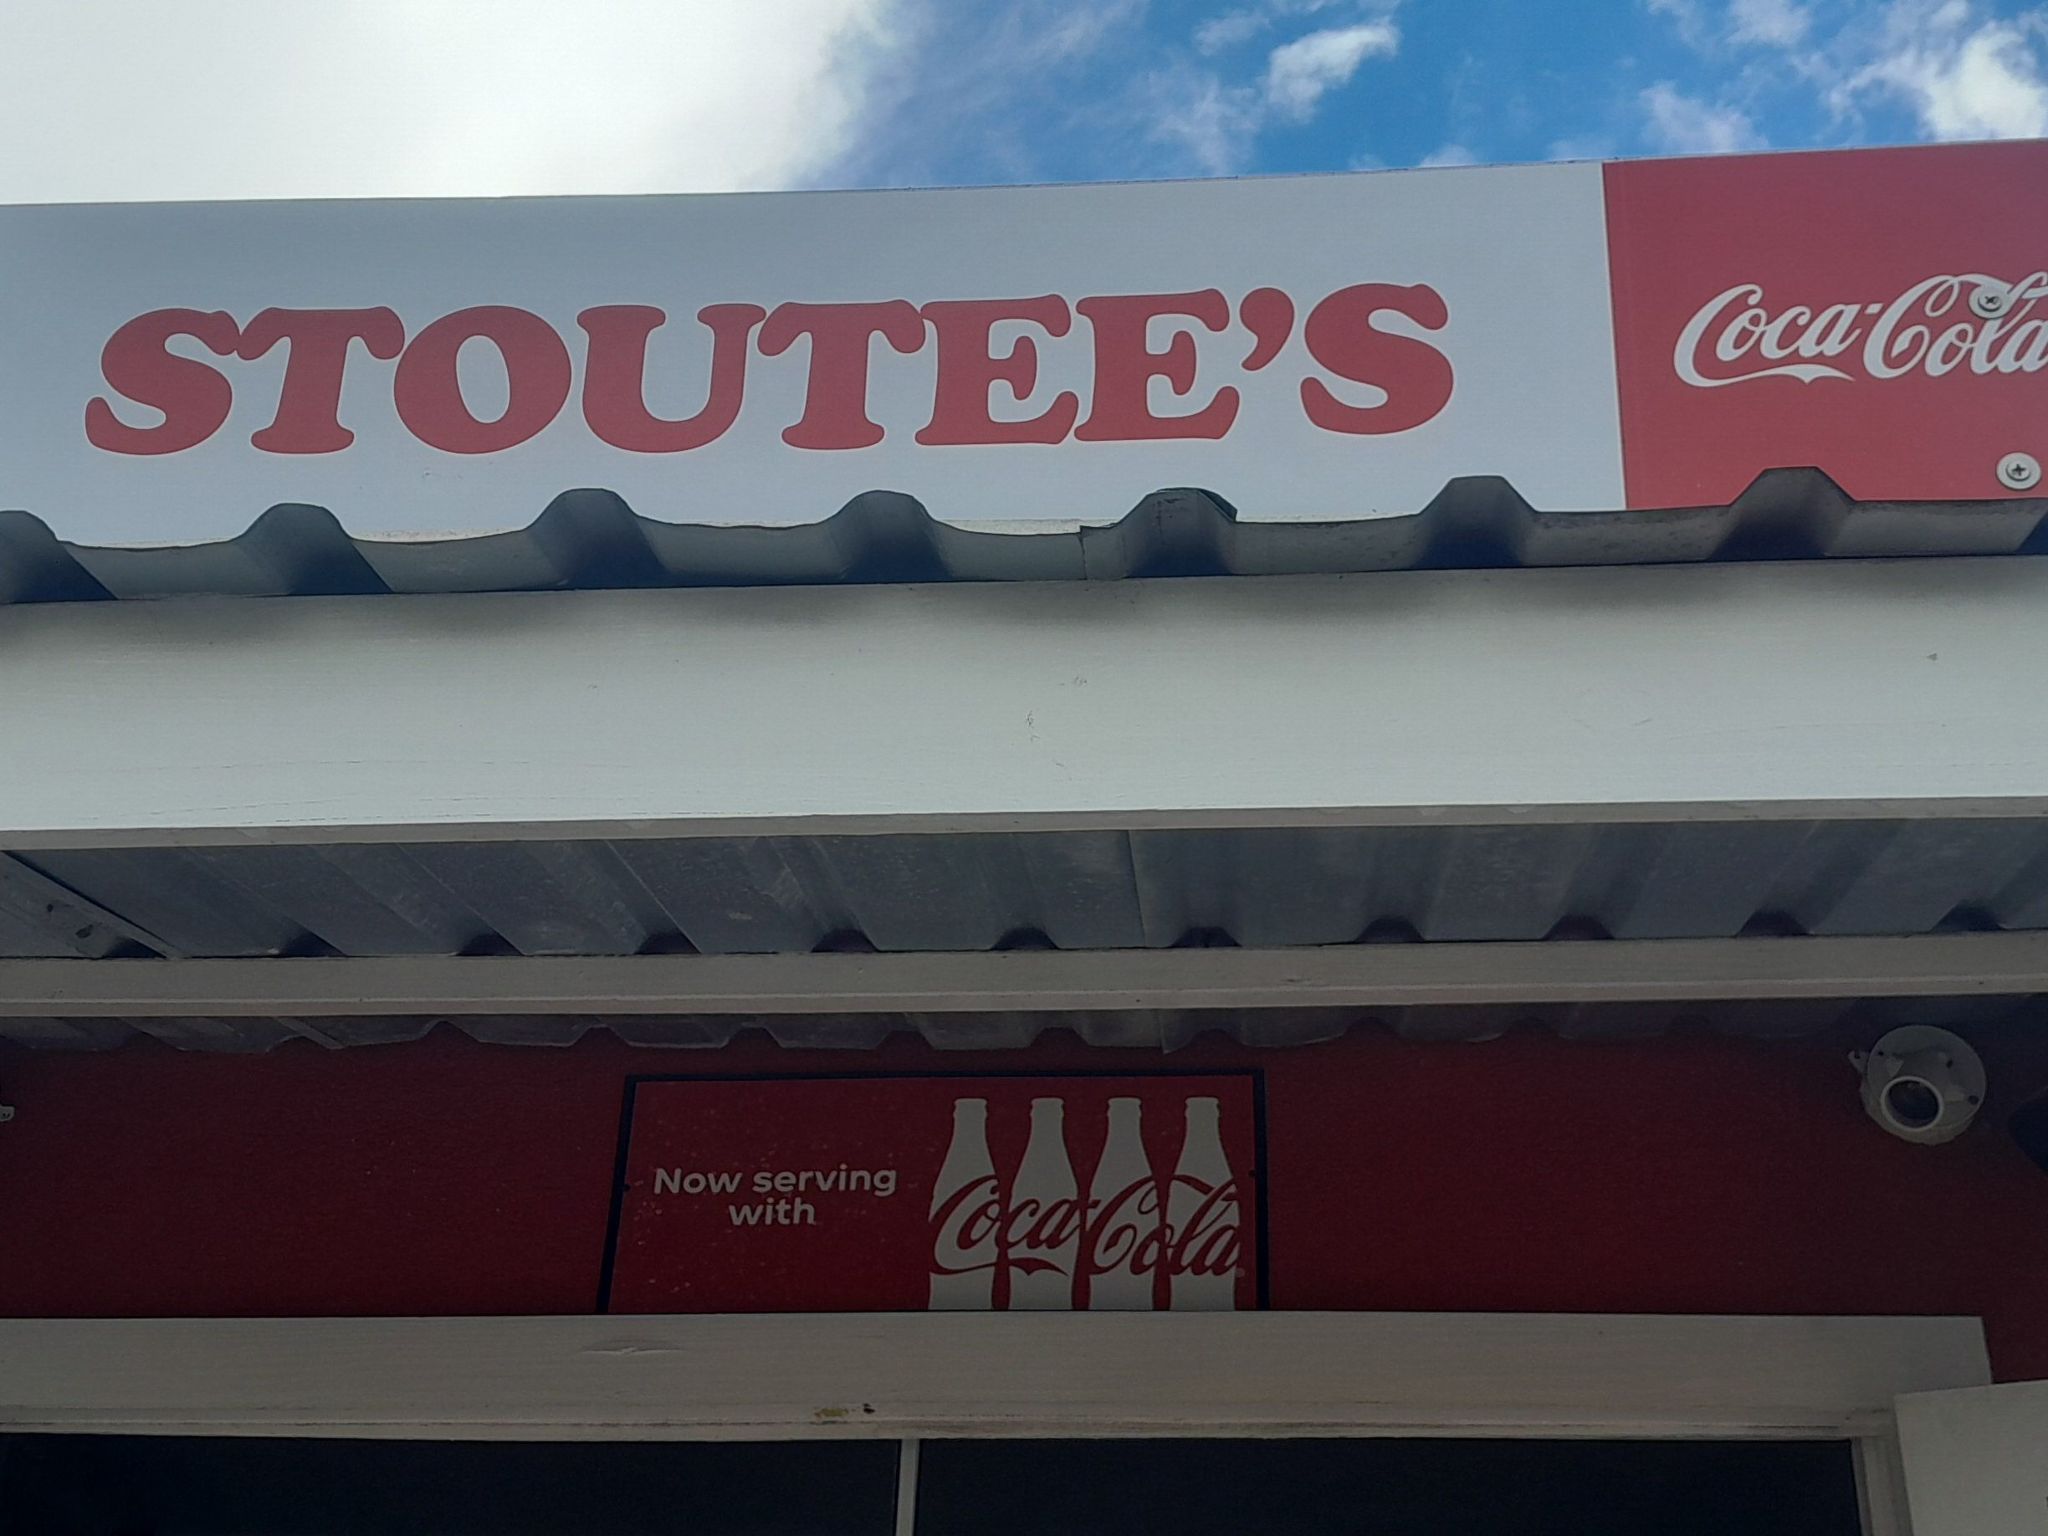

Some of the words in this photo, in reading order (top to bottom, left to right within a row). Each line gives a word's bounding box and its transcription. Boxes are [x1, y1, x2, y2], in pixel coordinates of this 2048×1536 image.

[1674, 272, 2048, 387] Coca-Cola
[85, 283, 1453, 455] STOUTEE'S
[653, 1168, 743, 1194] Now
[752, 1163, 897, 1197] serving
[728, 1198, 815, 1226] with
